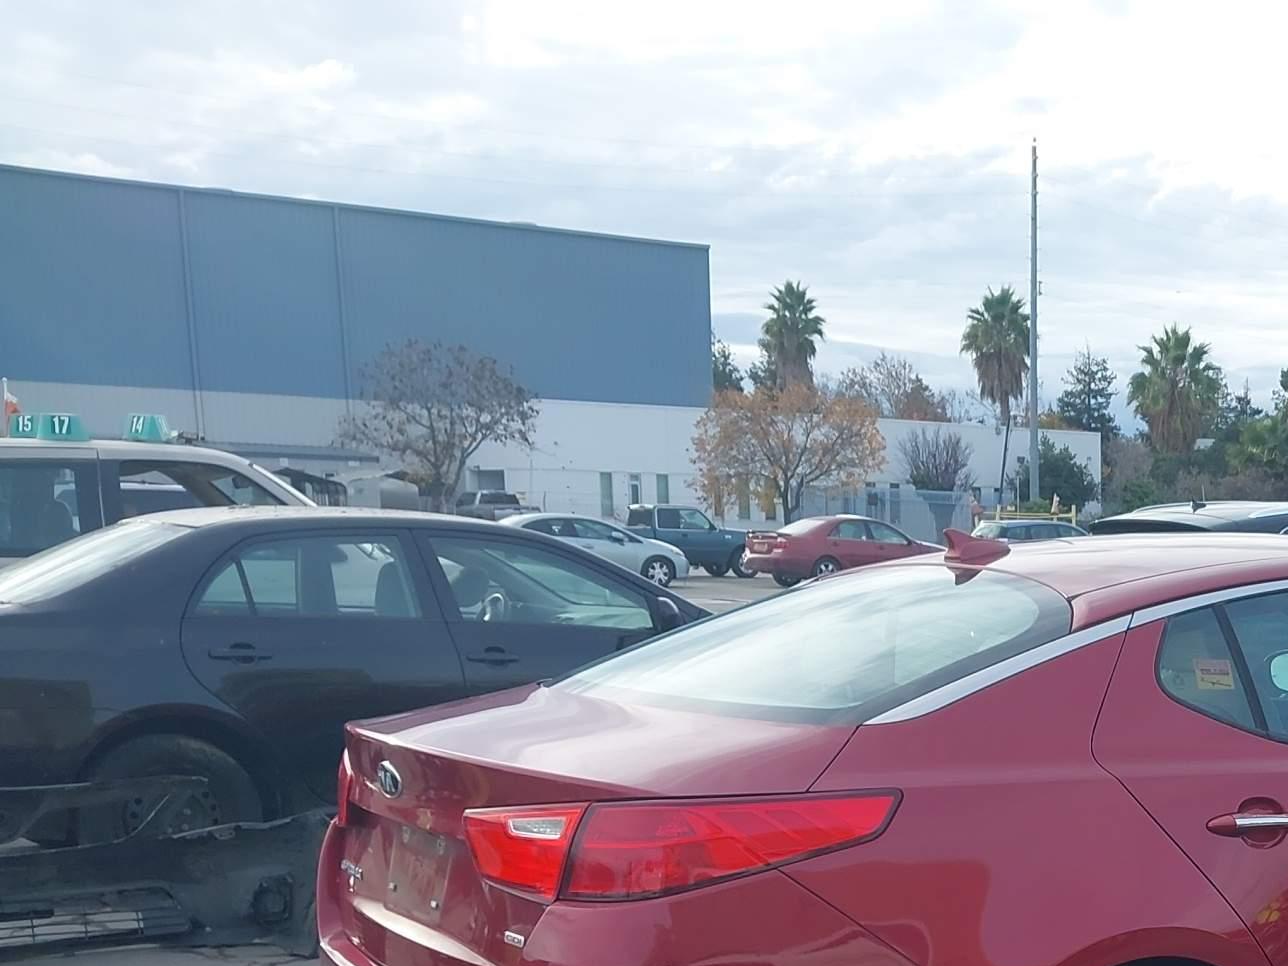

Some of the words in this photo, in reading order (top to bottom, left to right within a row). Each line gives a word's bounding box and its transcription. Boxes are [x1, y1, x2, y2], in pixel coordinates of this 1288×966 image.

[17, 415, 32, 432] 15
[52, 415, 69, 434] 17
[130, 415, 145, 433] 14
